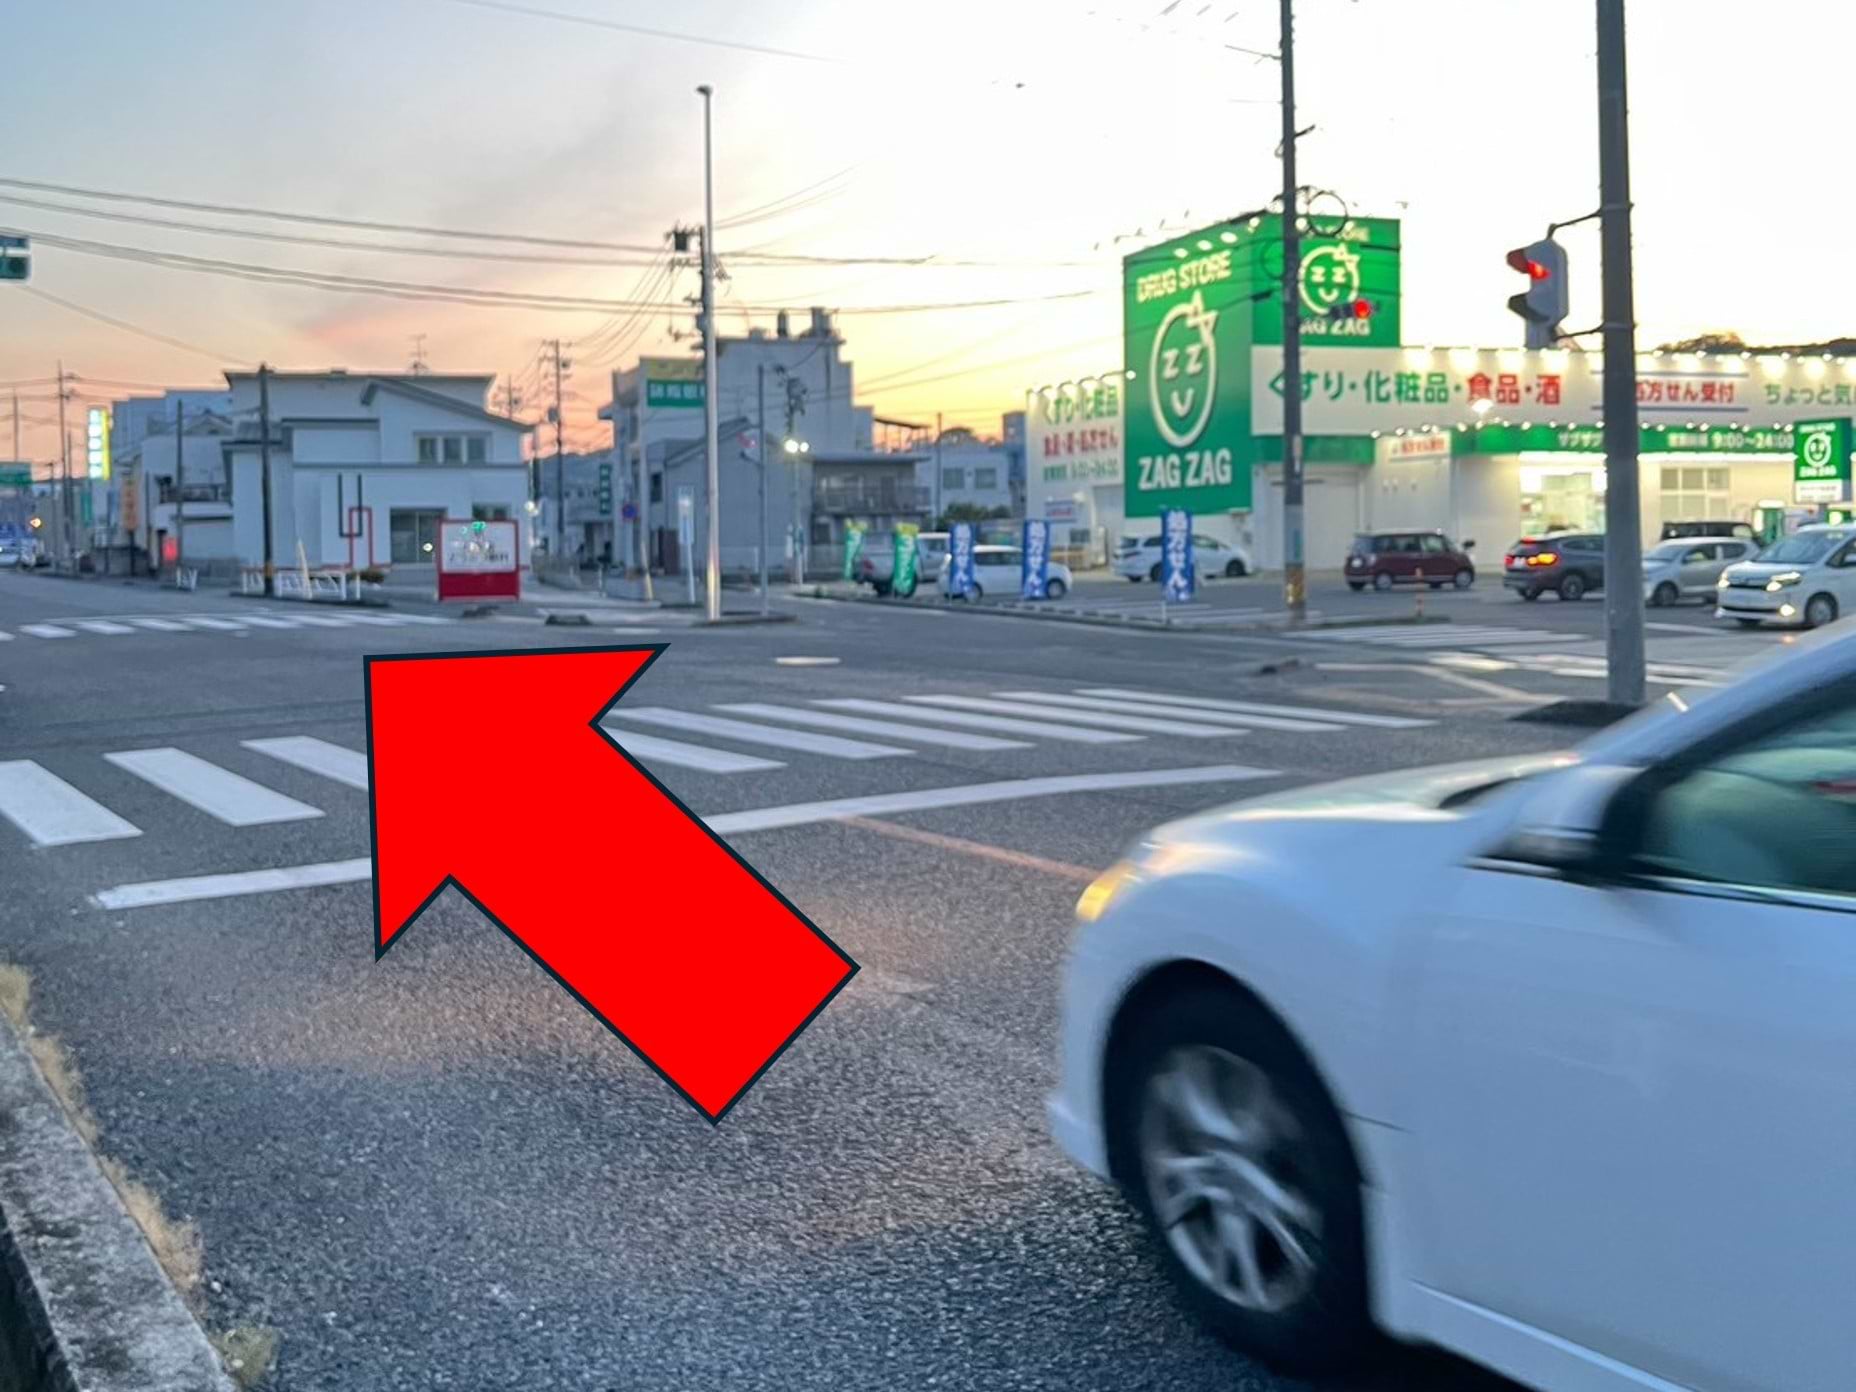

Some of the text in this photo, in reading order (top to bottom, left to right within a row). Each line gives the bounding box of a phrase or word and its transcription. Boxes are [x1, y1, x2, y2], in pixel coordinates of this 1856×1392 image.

[1136, 249, 1233, 303] DRUG STORE
[1763, 382, 1856, 406] ちょっと気
[1138, 453, 1181, 490] ZAG
[1185, 448, 1232, 487] ZAG
